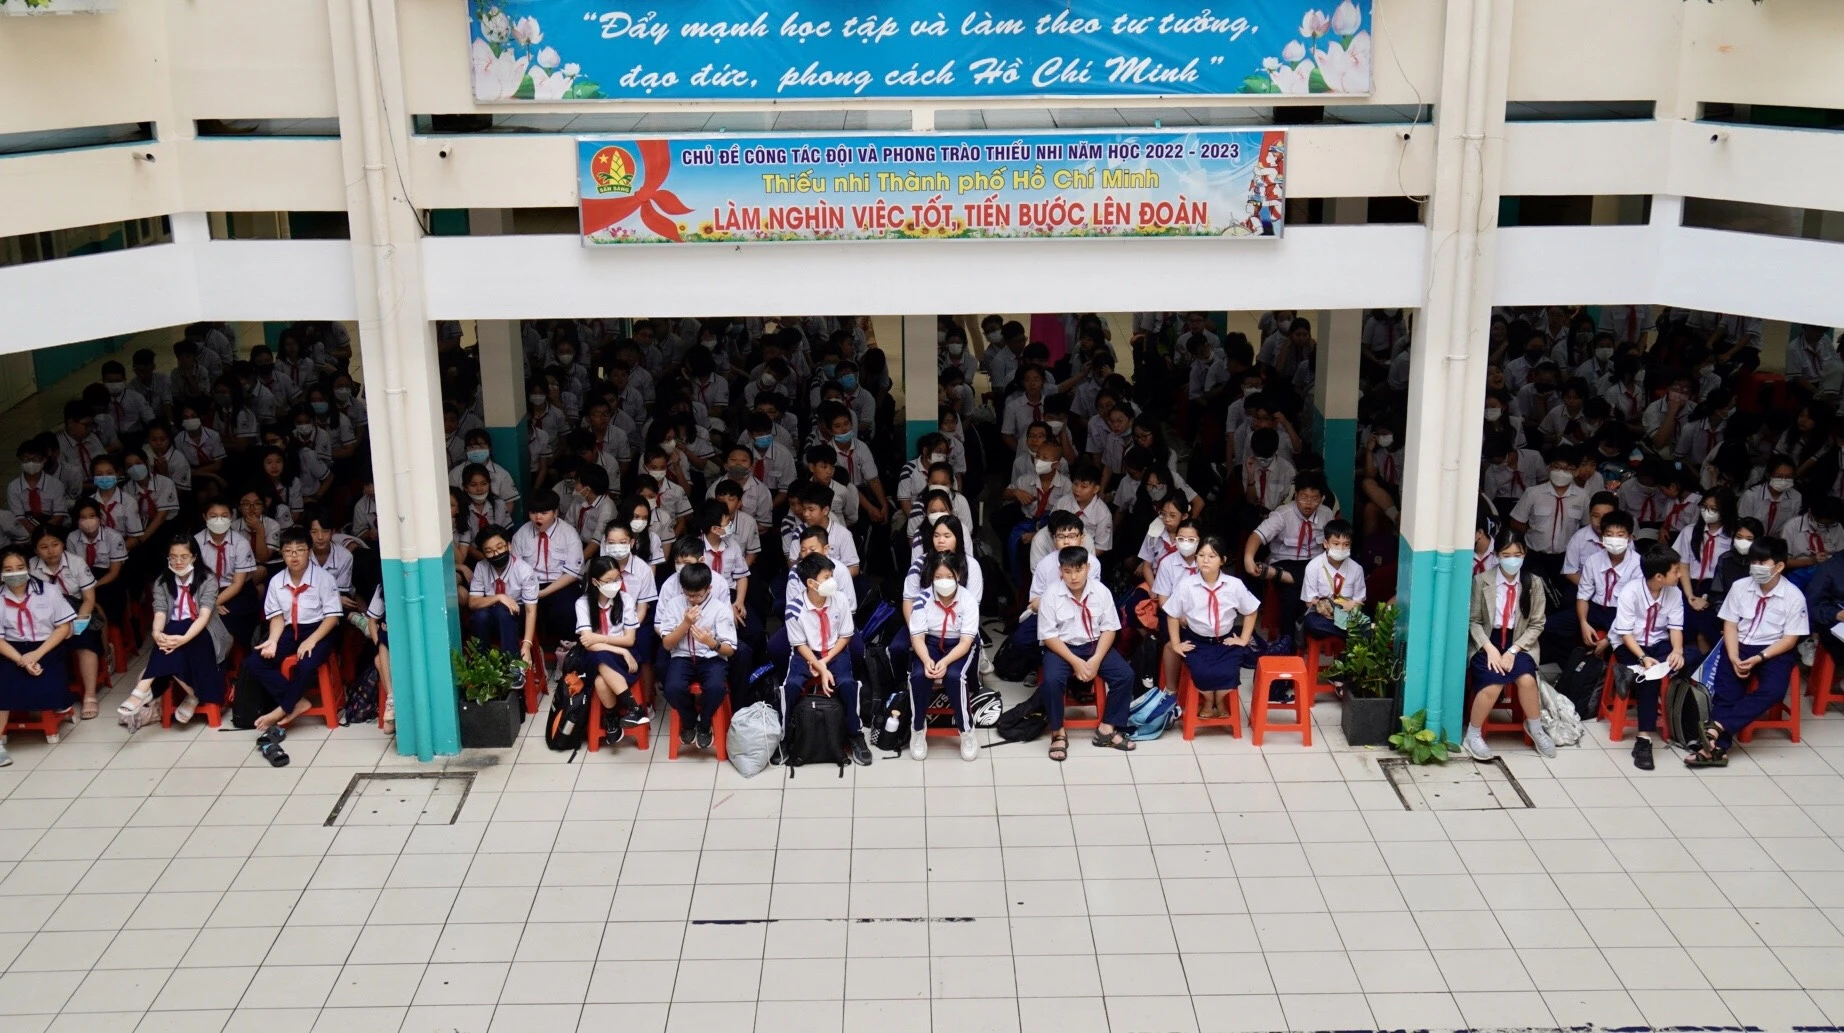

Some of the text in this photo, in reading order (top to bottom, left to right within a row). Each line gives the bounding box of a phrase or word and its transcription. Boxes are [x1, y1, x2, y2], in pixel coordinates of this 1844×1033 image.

[680, 12, 769, 44] mạnh
[780, 12, 832, 44] học
[842, 15, 899, 44] tập
[910, 13, 949, 36] và
[961, 12, 1026, 35] làm
[1035, 9, 1102, 35] theo
[1111, 14, 1155, 35] tư
[1158, 9, 1259, 41] tưởng,
[619, 64, 679, 94] đạo
[690, 63, 758, 88] đức,
[777, 62, 873, 93] phong
[884, 60, 955, 86] cách
[969, 57, 1024, 85] Hồ
[1031, 56, 1093, 88] Chí
[682, 145, 714, 165] CHỦ
[719, 144, 739, 164] ĐỀ
[744, 145, 786, 164] CÔNG
[791, 144, 821, 163] TÁC
[825, 145, 852, 166] ĐỘI
[857, 144, 878, 163] VÀ
[883, 147, 935, 162] PHONG
[940, 142, 980, 161] TRÀO
[985, 140, 1031, 161] THIẾU
[1036, 145, 1062, 160] NHI
[1068, 141, 1102, 159] NĂM
[1108, 144, 1140, 162] HỌC
[1145, 144, 1183, 159] 2022
[1200, 144, 1239, 159] 2023
[762, 163, 1160, 195] Thiếu nhi Thành phố Hồ Chí Minh
[714, 193, 1207, 235] LÀM NGHÌN VIỆC TỐT, TIẾN BƯỚC LÊN ĐOÀN
